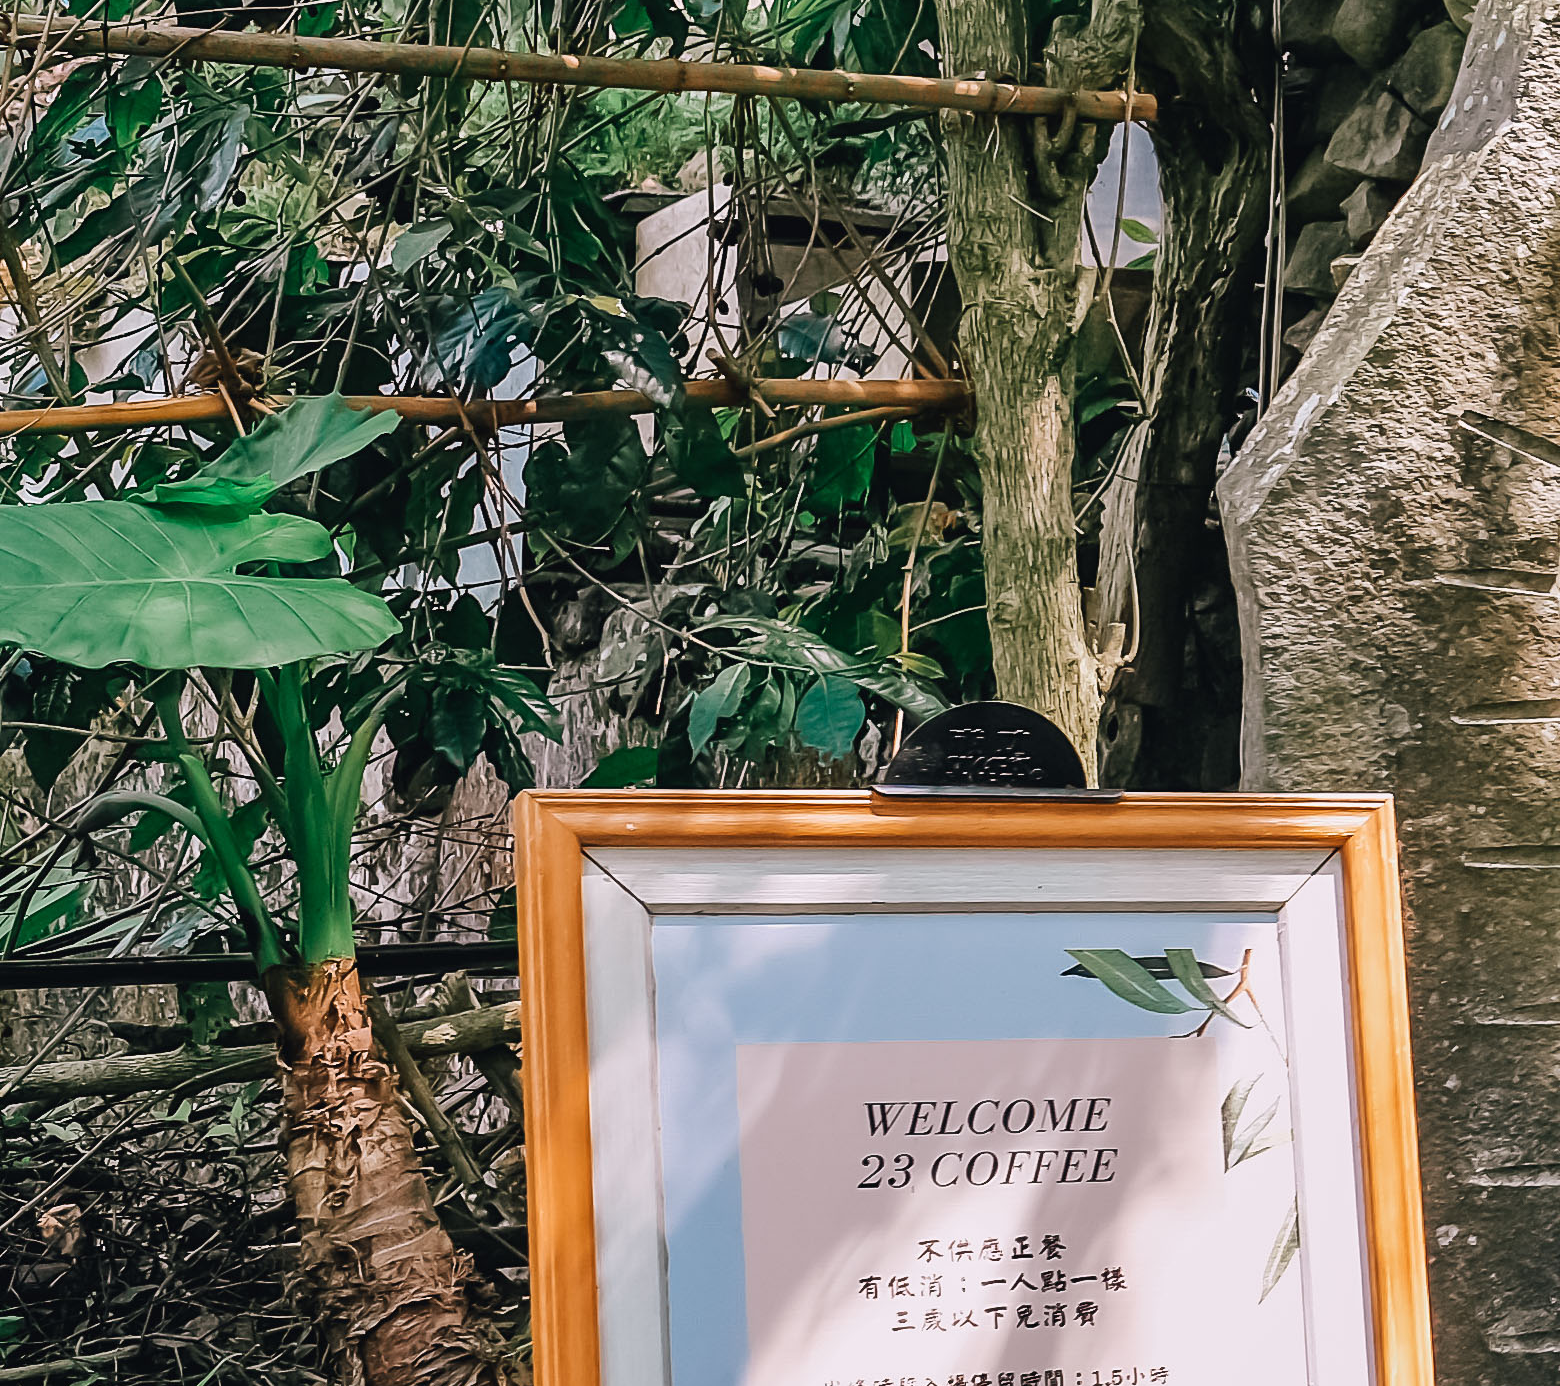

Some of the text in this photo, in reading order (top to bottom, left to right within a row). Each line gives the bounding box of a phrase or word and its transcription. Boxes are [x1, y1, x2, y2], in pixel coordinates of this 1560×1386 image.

[863, 1097, 1112, 1137] WELCOME
[857, 1148, 1119, 1189] 23 COFFEE
[917, 1234, 1067, 1263] 不供應正餐
[892, 1301, 1099, 1332] 三歲以下免消費
